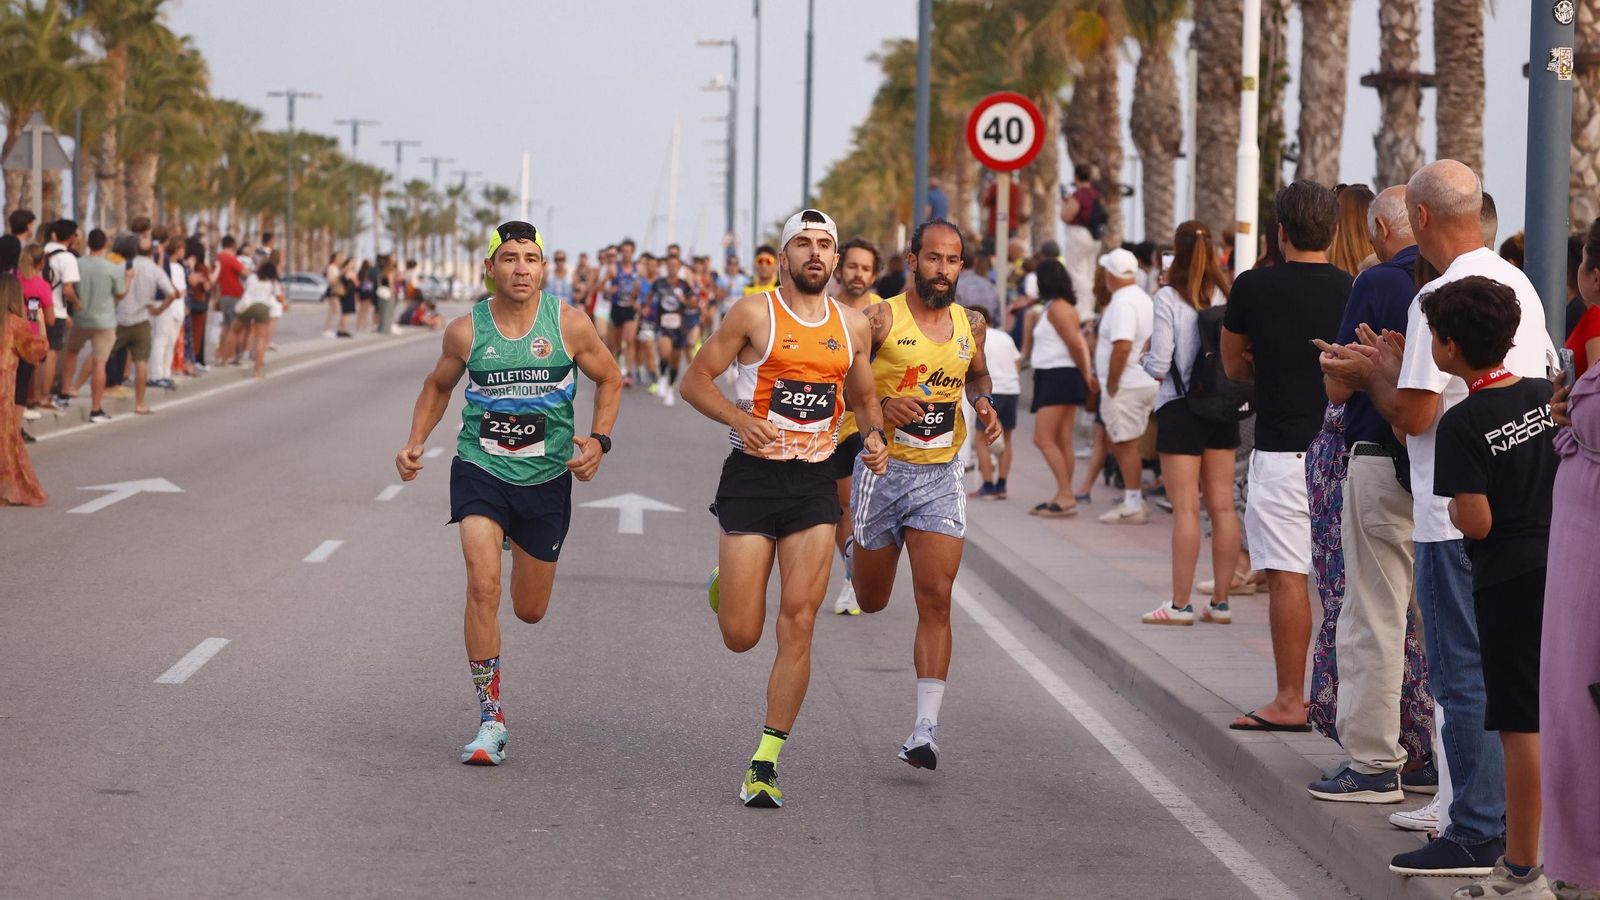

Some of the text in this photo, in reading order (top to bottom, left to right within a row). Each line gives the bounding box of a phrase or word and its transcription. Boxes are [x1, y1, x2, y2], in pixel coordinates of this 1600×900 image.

[983, 116, 1024, 145] 40
[487, 369, 549, 384] ATLETISMO
[780, 391, 828, 408] 2874
[489, 421, 536, 436] 2340
